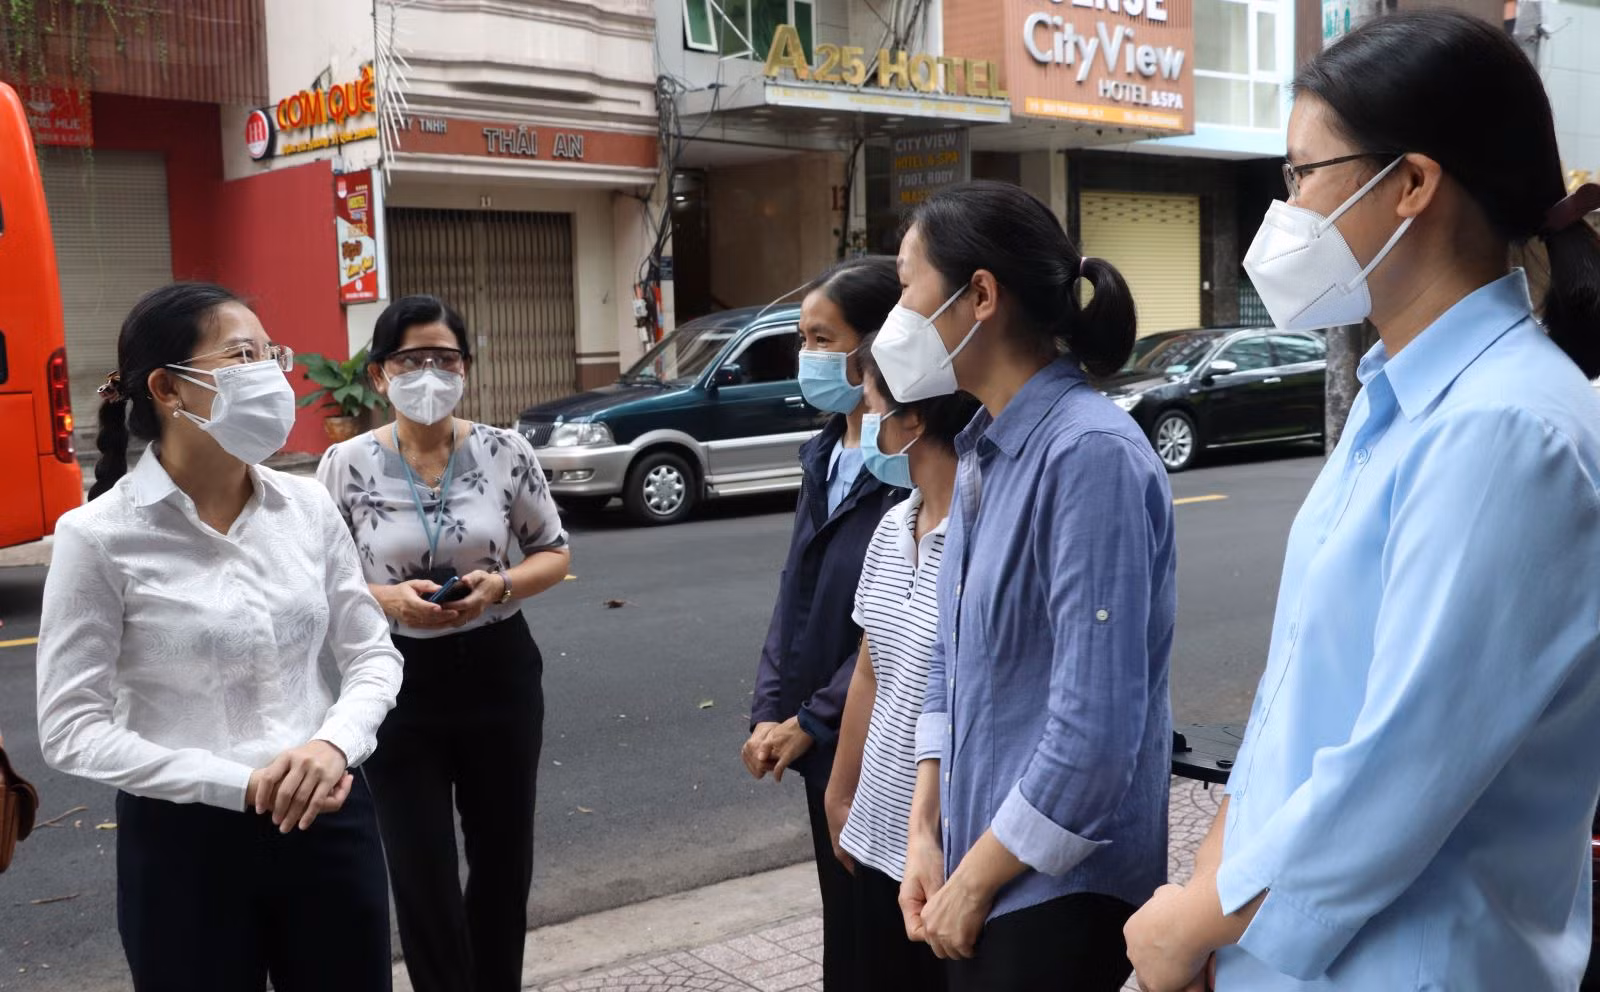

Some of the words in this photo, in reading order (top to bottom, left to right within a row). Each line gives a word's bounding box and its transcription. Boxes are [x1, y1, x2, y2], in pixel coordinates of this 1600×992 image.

[876, 48, 1009, 99] HOTEL
[1098, 79, 1148, 105] HOTEL
[419, 118, 448, 133] TNHH
[553, 133, 584, 158] AN
[895, 138, 921, 152] CITY
[924, 132, 957, 149] VIEW
